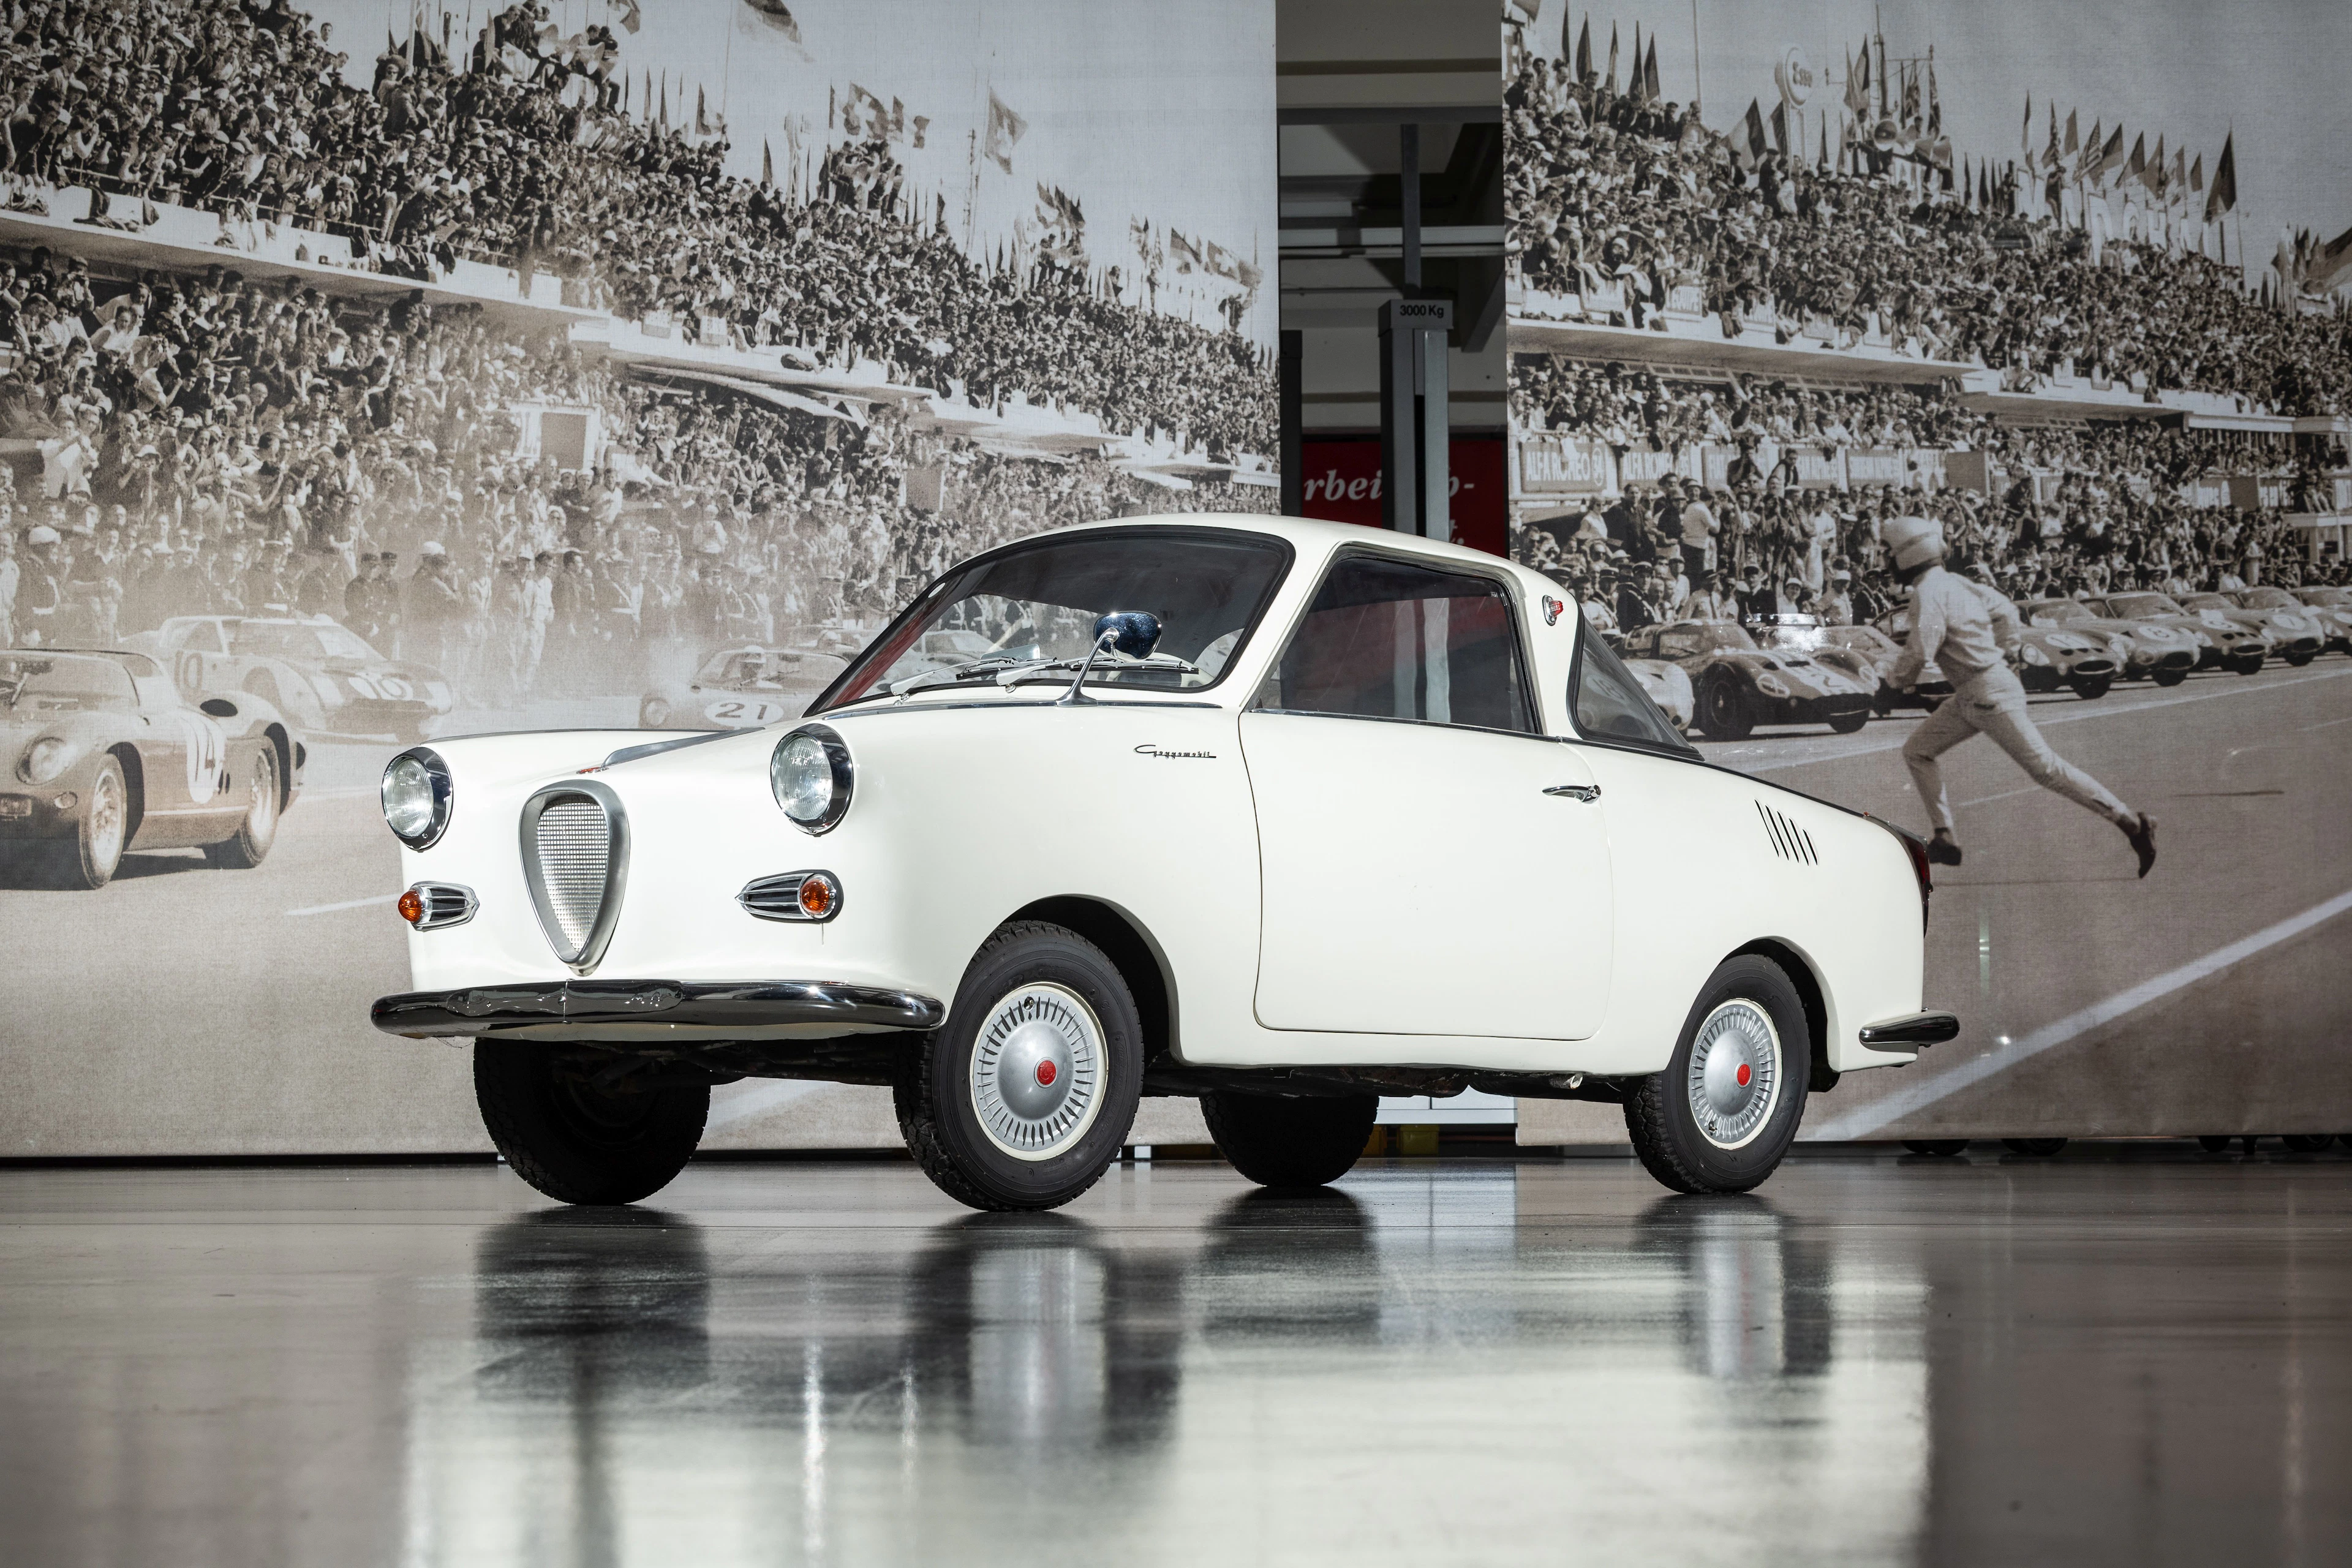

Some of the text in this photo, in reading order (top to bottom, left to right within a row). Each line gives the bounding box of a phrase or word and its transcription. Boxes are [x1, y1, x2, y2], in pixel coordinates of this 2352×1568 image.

[1400, 304, 1444, 318] 3000 Kg
[1303, 469, 1382, 501] rbei
[715, 702, 768, 720] 21
